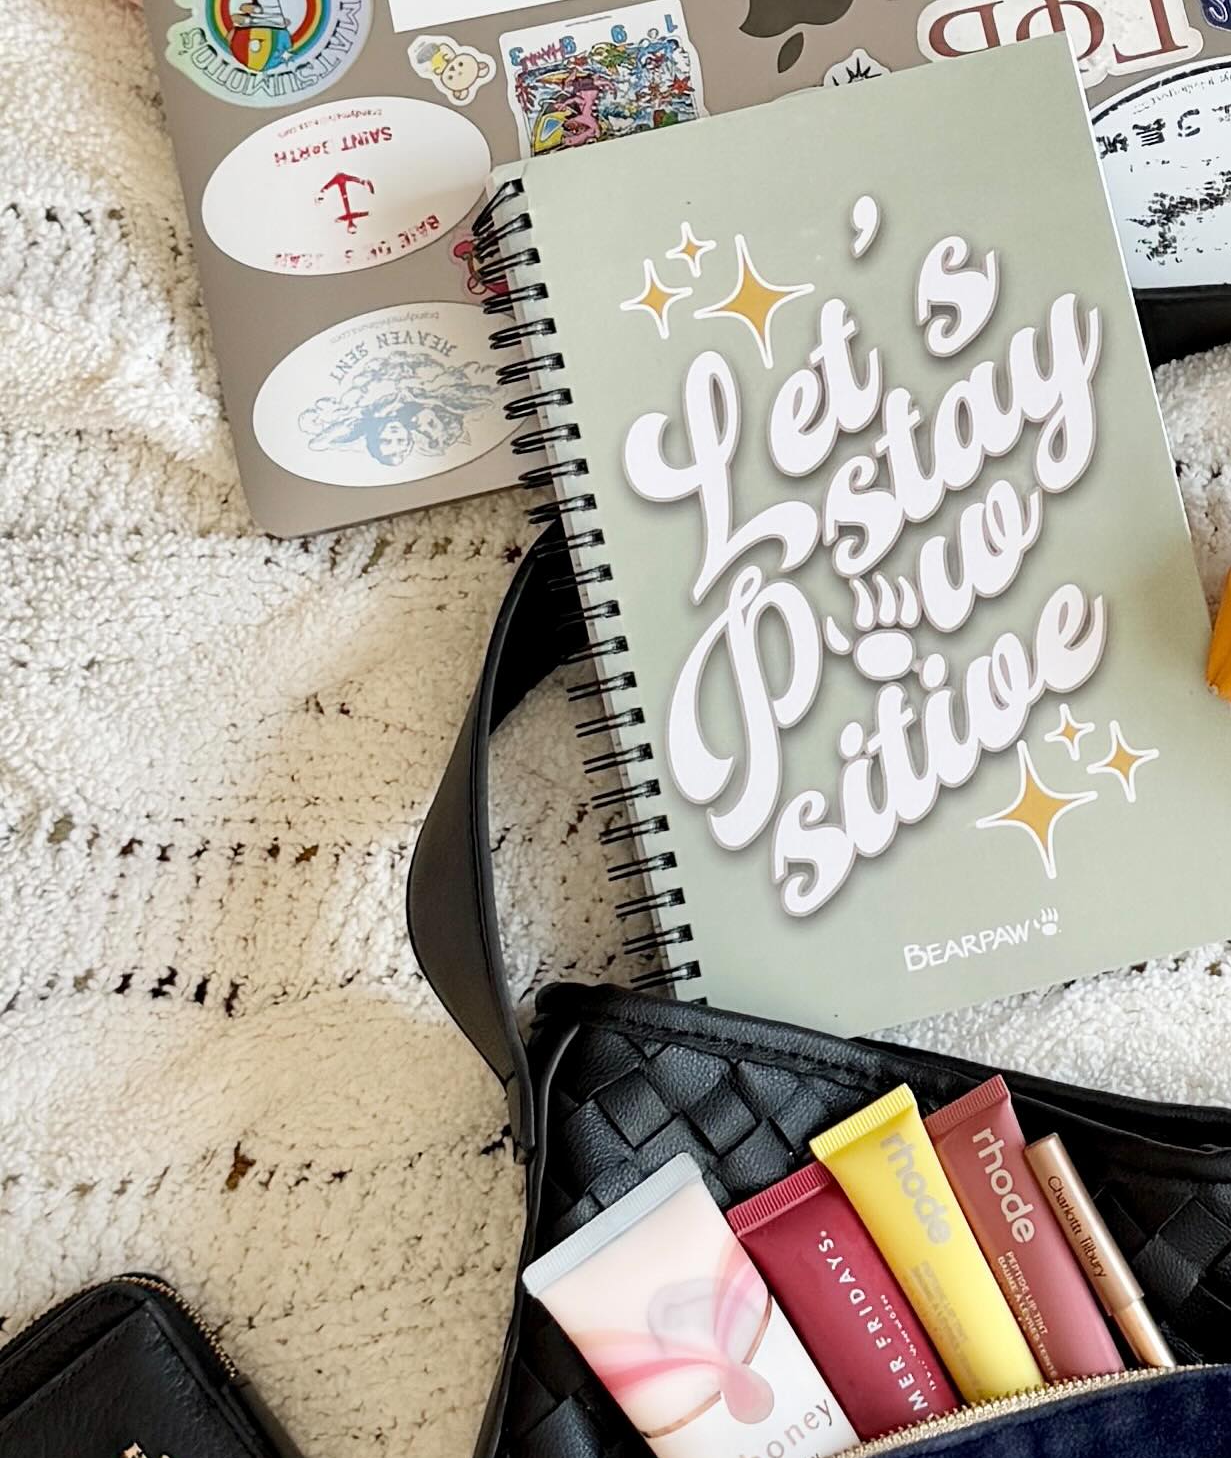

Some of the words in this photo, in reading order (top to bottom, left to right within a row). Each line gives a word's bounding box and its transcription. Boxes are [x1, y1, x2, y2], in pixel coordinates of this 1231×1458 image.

[822, 291, 1101, 576] stay
[772, 582, 1106, 919] sitive
[903, 914, 1034, 974] BEARPAW
[880, 1132, 952, 1246] rhode
[972, 1126, 1036, 1244] rhode
[1079, 1235, 1108, 1279] Tilbury
